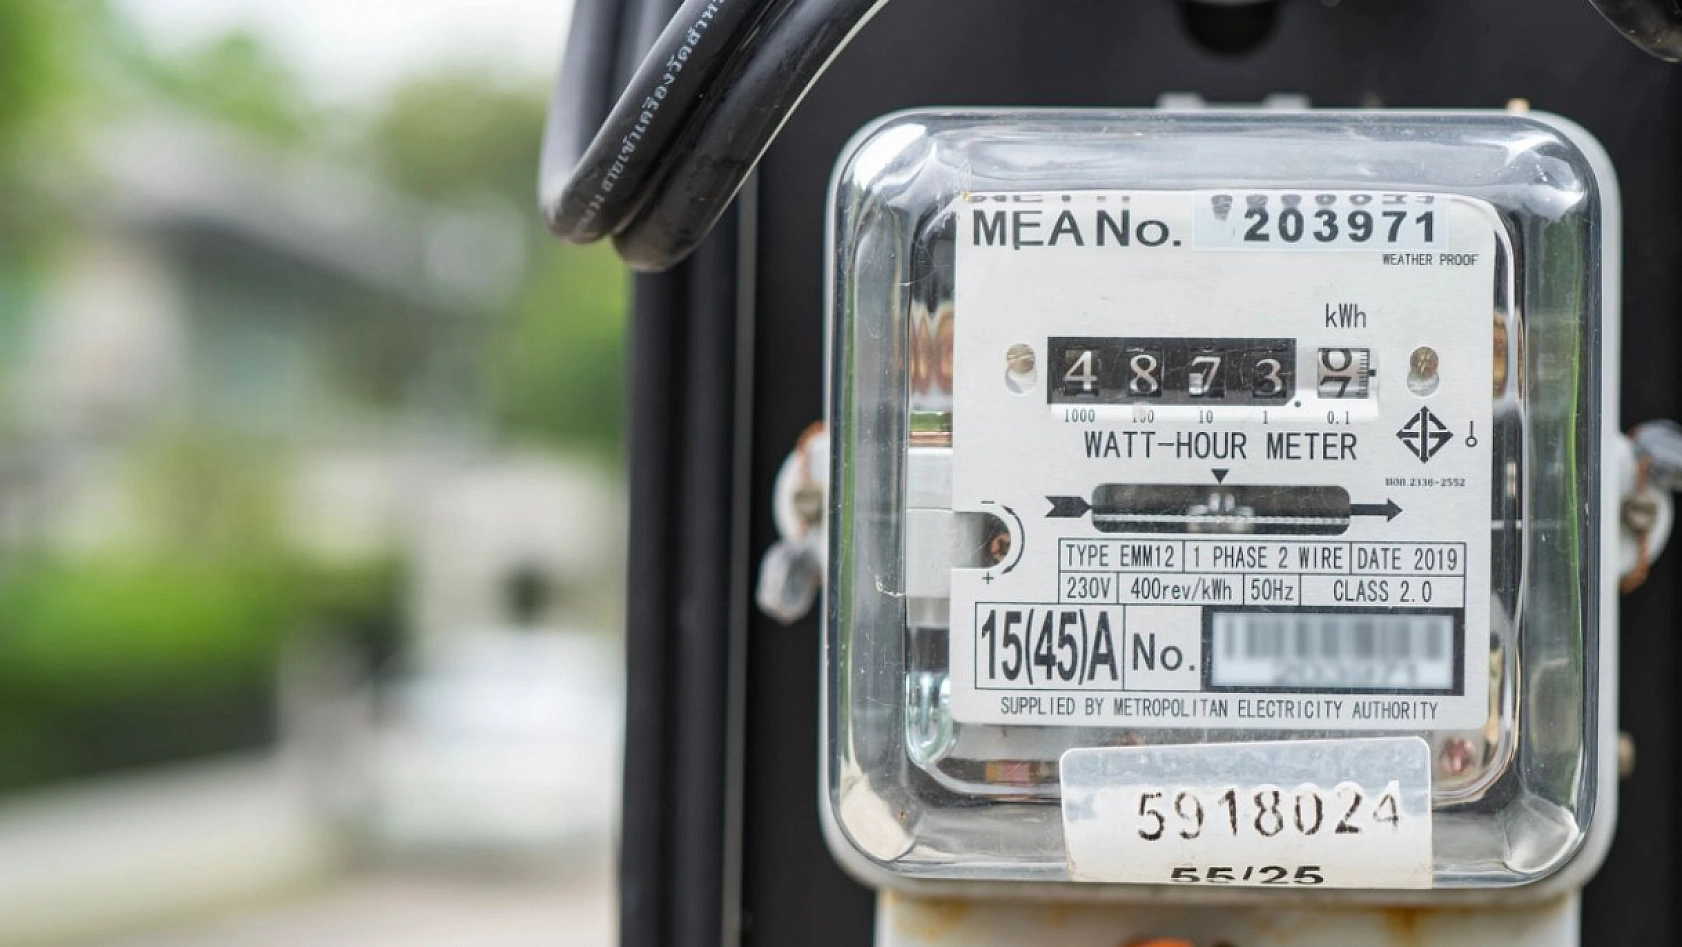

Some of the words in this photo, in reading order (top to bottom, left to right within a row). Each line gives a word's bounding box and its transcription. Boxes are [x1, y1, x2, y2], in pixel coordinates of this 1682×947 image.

[973, 209, 1085, 250] MEA
[1096, 209, 1182, 247] No.
[1243, 209, 1434, 243] 203971
[1382, 253, 1433, 266] WEATHER
[1439, 253, 1480, 266] PROOF
[1325, 303, 1367, 329] kWh
[1064, 409, 1096, 423] 1000
[1199, 409, 1214, 424] 10
[1261, 410, 1269, 425] 1
[1326, 410, 1352, 425] 0.1
[1084, 431, 1247, 460] WATT-HOUR
[1266, 432, 1357, 460] METER
[1066, 545, 1110, 568] TYPE
[1120, 545, 1175, 568] EMM12
[1193, 546, 1201, 568] 1
[1213, 546, 1268, 569] PHASE
[1278, 546, 1288, 569] 2
[1299, 547, 1343, 570] WIRE
[1357, 548, 1402, 571] DATE
[1413, 547, 1458, 571] 2019
[1066, 577, 1111, 599] 230V
[1130, 577, 1233, 601] 400rev/kWh
[1250, 578, 1294, 601] 50Hz
[1333, 580, 1389, 603] CLASS
[1399, 580, 1433, 603] 2.0
[981, 609, 1119, 685] 15(45)A
[1132, 633, 1196, 672] No.
[1000, 696, 1076, 716] SUPPLIED
[1084, 696, 1105, 716] BY
[1113, 697, 1228, 717] METROPOLITAN
[1237, 698, 1343, 719] ELECTRICITY
[1352, 699, 1439, 720] AUTHORITY
[1138, 788, 1400, 842] 5918024
